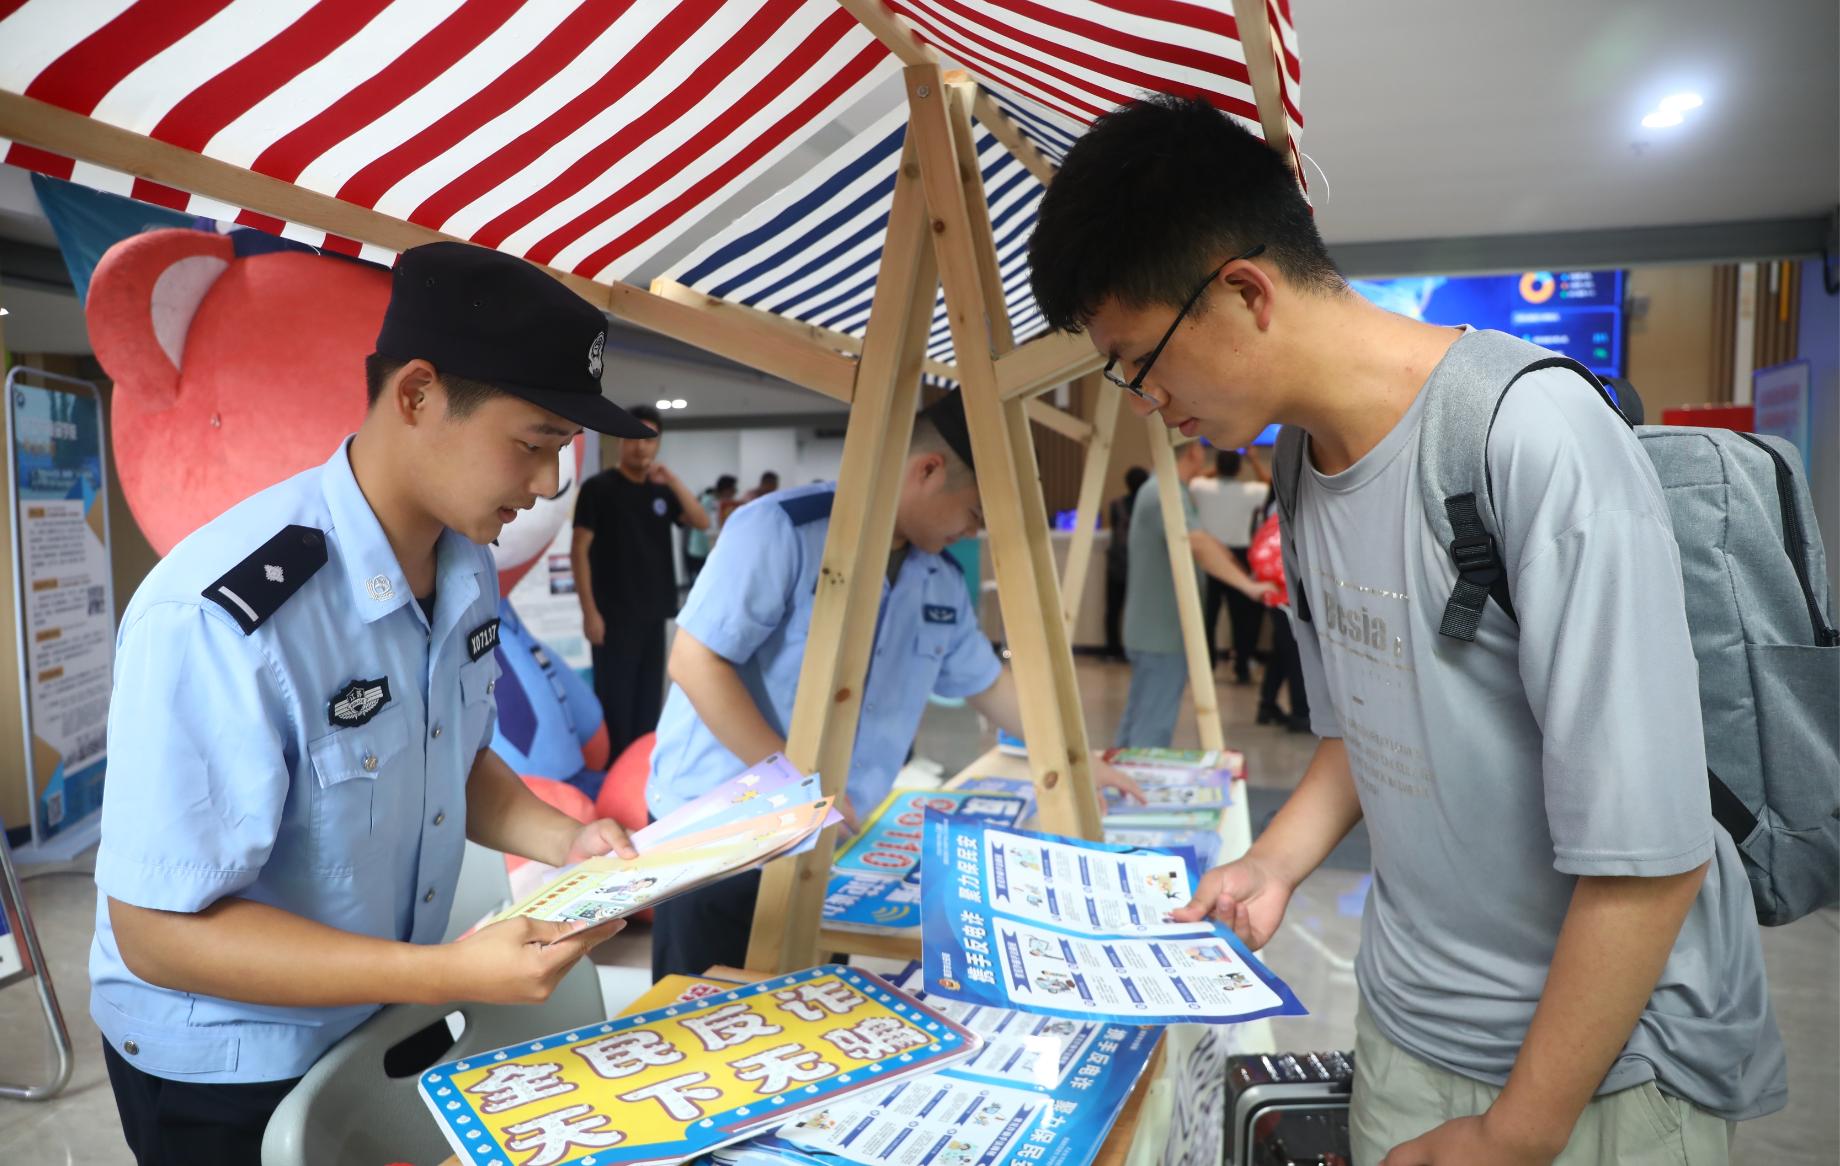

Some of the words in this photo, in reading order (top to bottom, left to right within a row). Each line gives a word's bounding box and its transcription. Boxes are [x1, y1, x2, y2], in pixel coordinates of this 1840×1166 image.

[471, 624, 497, 655] X07137
[956, 835, 982, 904] 聚力保民安
[962, 909, 996, 986] 携手反电诈
[465, 979, 869, 1114] 全民反诈
[1070, 1027, 1127, 1090] 携手反电诈
[501, 1017, 932, 1166] 天下无骗
